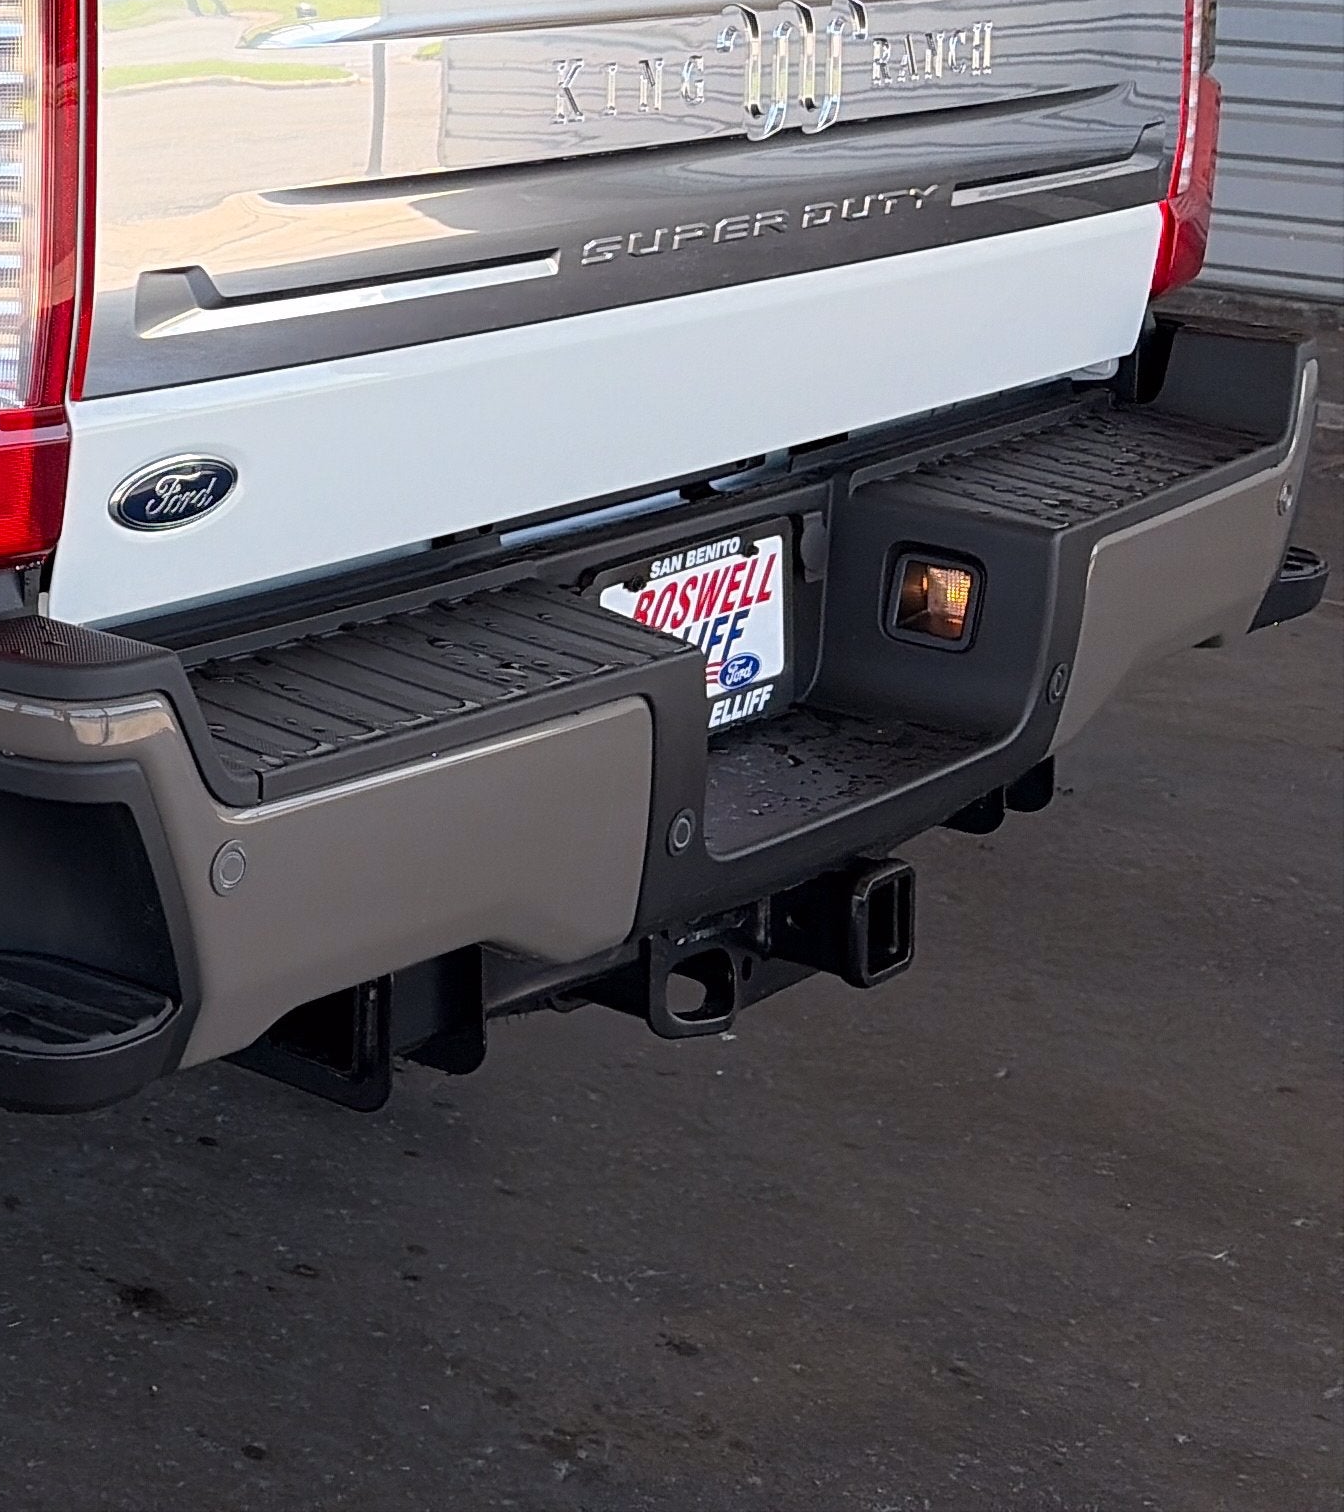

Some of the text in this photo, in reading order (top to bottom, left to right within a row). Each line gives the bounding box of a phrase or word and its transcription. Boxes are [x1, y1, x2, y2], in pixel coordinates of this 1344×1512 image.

[550, 19, 994, 126] KING RANCH
[581, 184, 940, 267] SUPER DUTY
[144, 469, 219, 515] Ford
[650, 535, 742, 580] SAN BENITO
[633, 552, 778, 632] BOSWELL
[708, 683, 774, 729] ELLIFF
